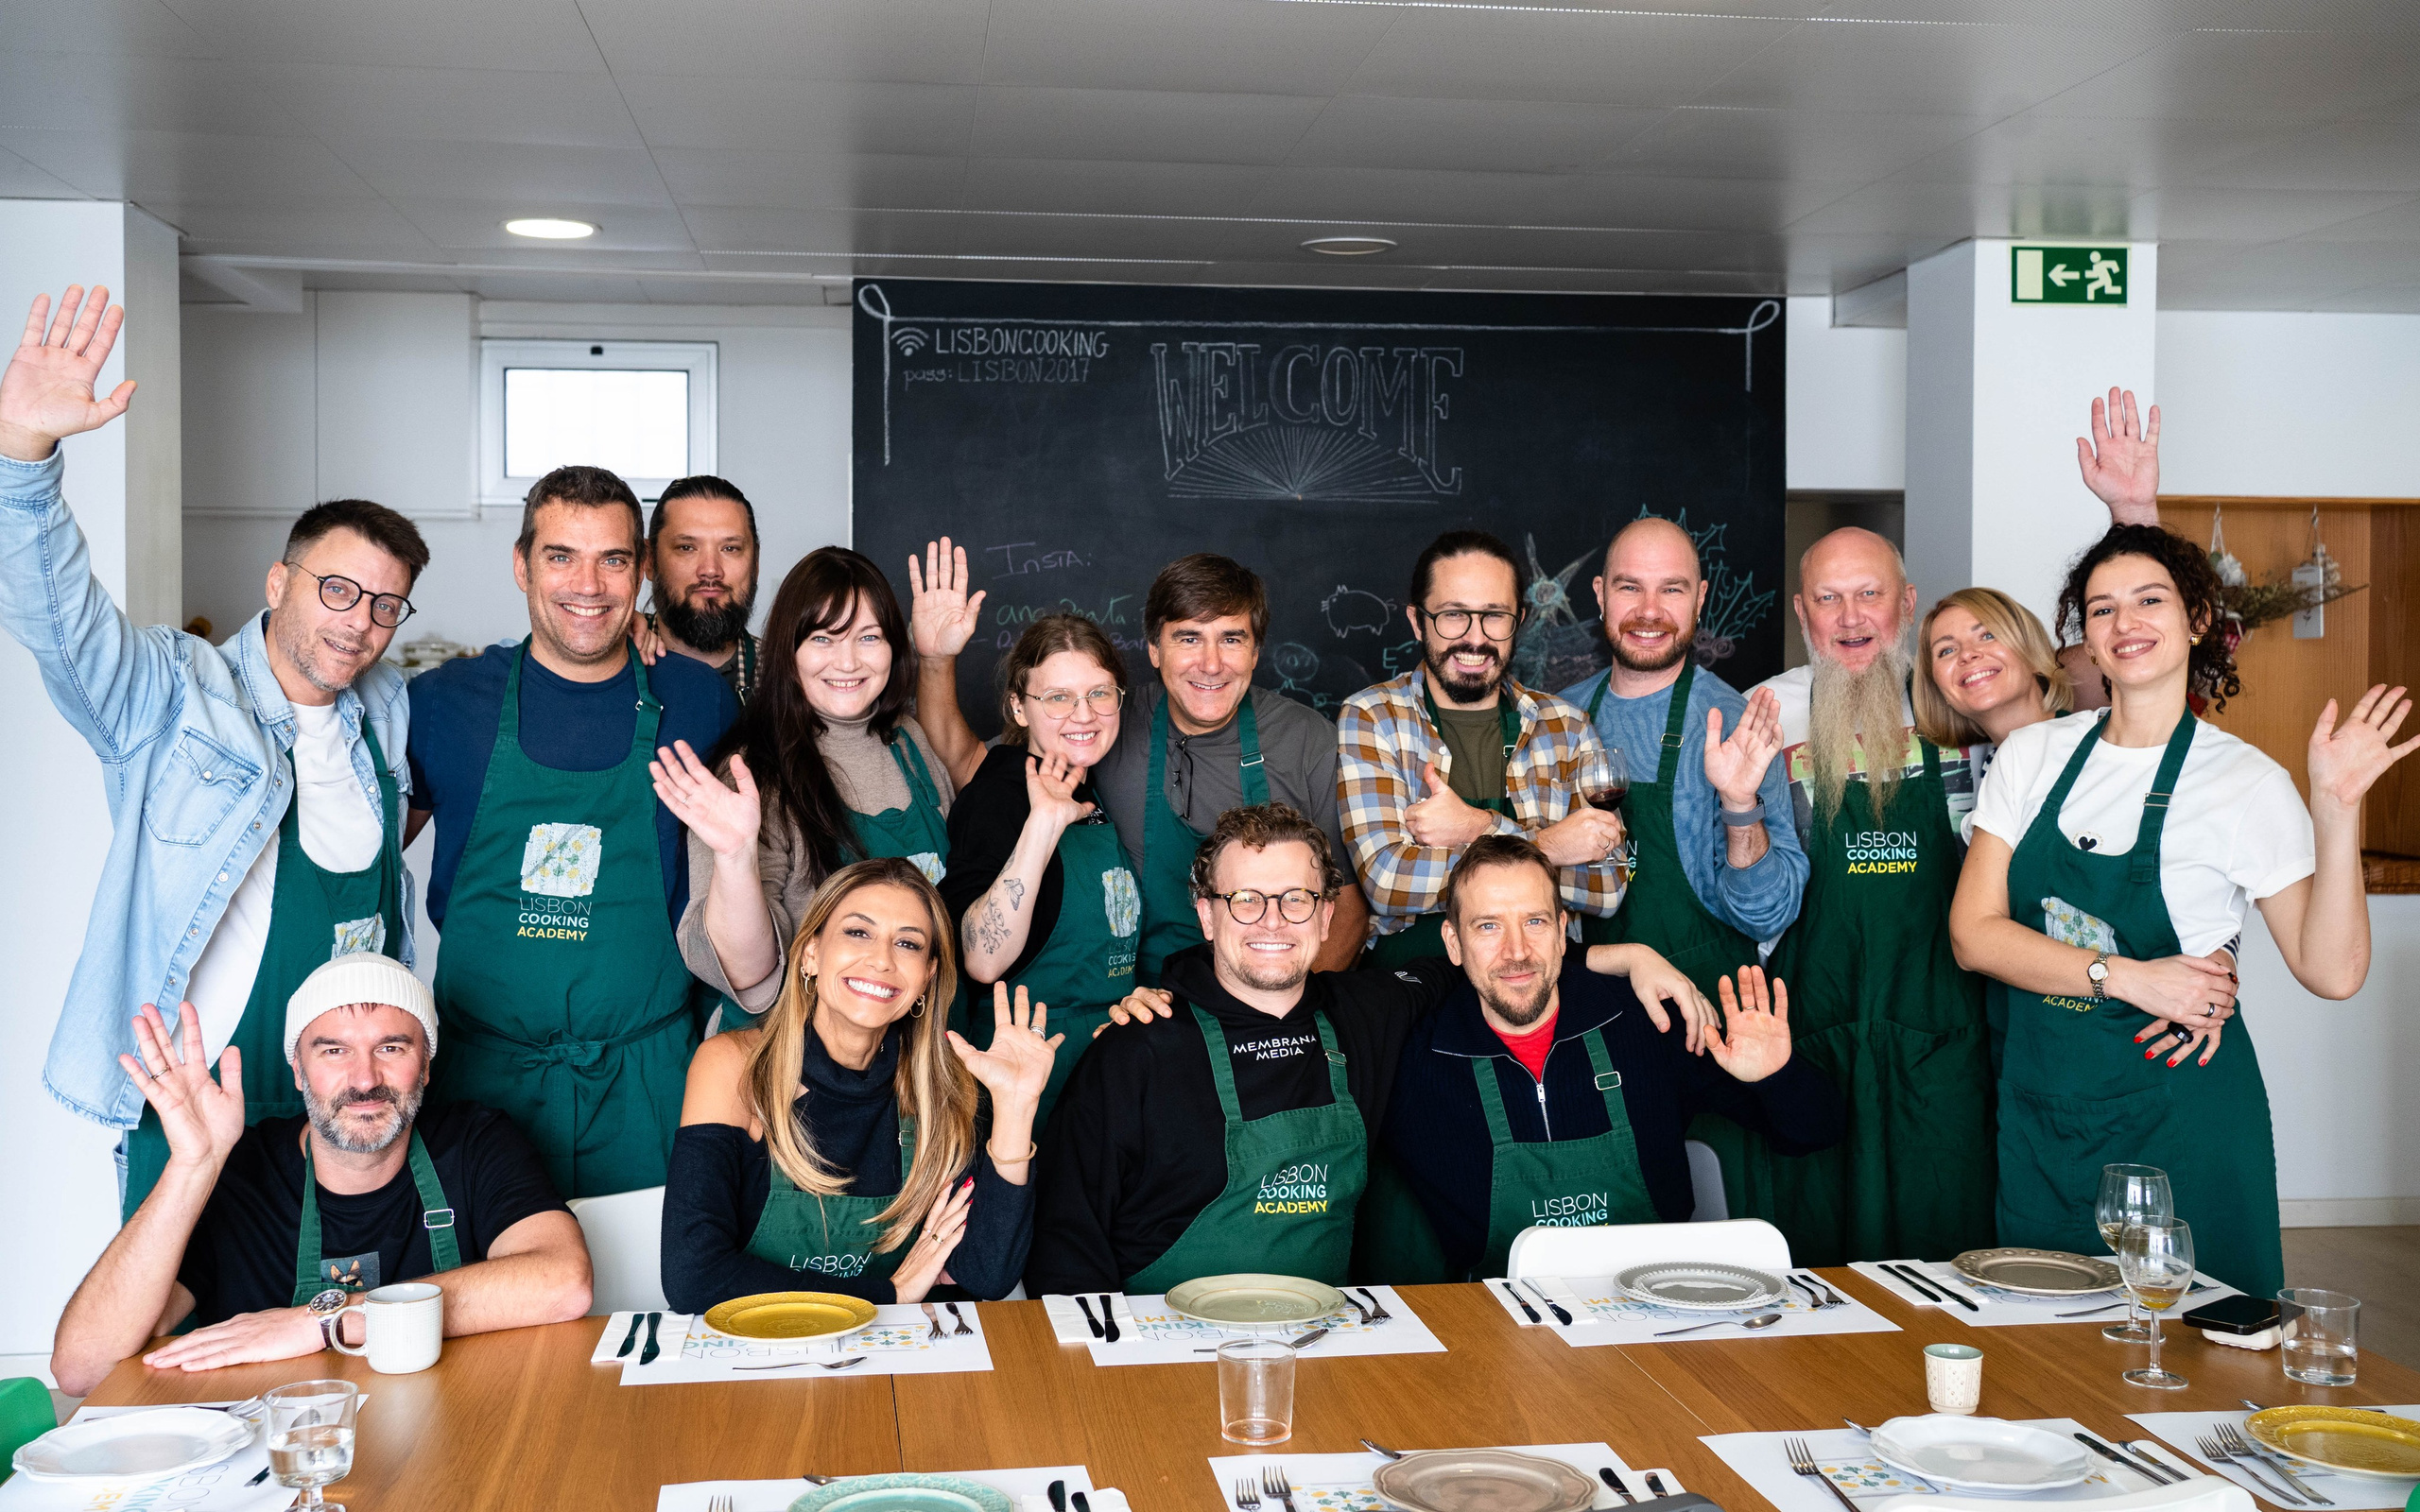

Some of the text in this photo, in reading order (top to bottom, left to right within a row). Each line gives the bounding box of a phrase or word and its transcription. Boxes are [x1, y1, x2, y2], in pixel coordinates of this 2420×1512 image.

[936, 327, 1110, 359] LISBONCOOKING
[958, 357, 1091, 384] LISBON2017
[1150, 342, 1464, 495] WELCOME
[1845, 831, 1917, 849] LISBON
[1846, 848, 1917, 861] COOKING
[1847, 861, 1918, 874] ACADEMY
[519, 897, 593, 916] LISBON
[518, 913, 589, 929] COOKING
[517, 926, 588, 942] ACADEMY
[2042, 995, 2099, 1012] ACADEM
[1233, 1034, 1317, 1055] MEMBRANA
[1255, 1046, 1305, 1060] MEDIA
[1260, 1163, 1328, 1189] LISBON
[1256, 1184, 1327, 1199] COOKING
[1254, 1200, 1328, 1213] ACADEMY
[1531, 1192, 1607, 1218] LISBON
[789, 1251, 872, 1273] LISBON
